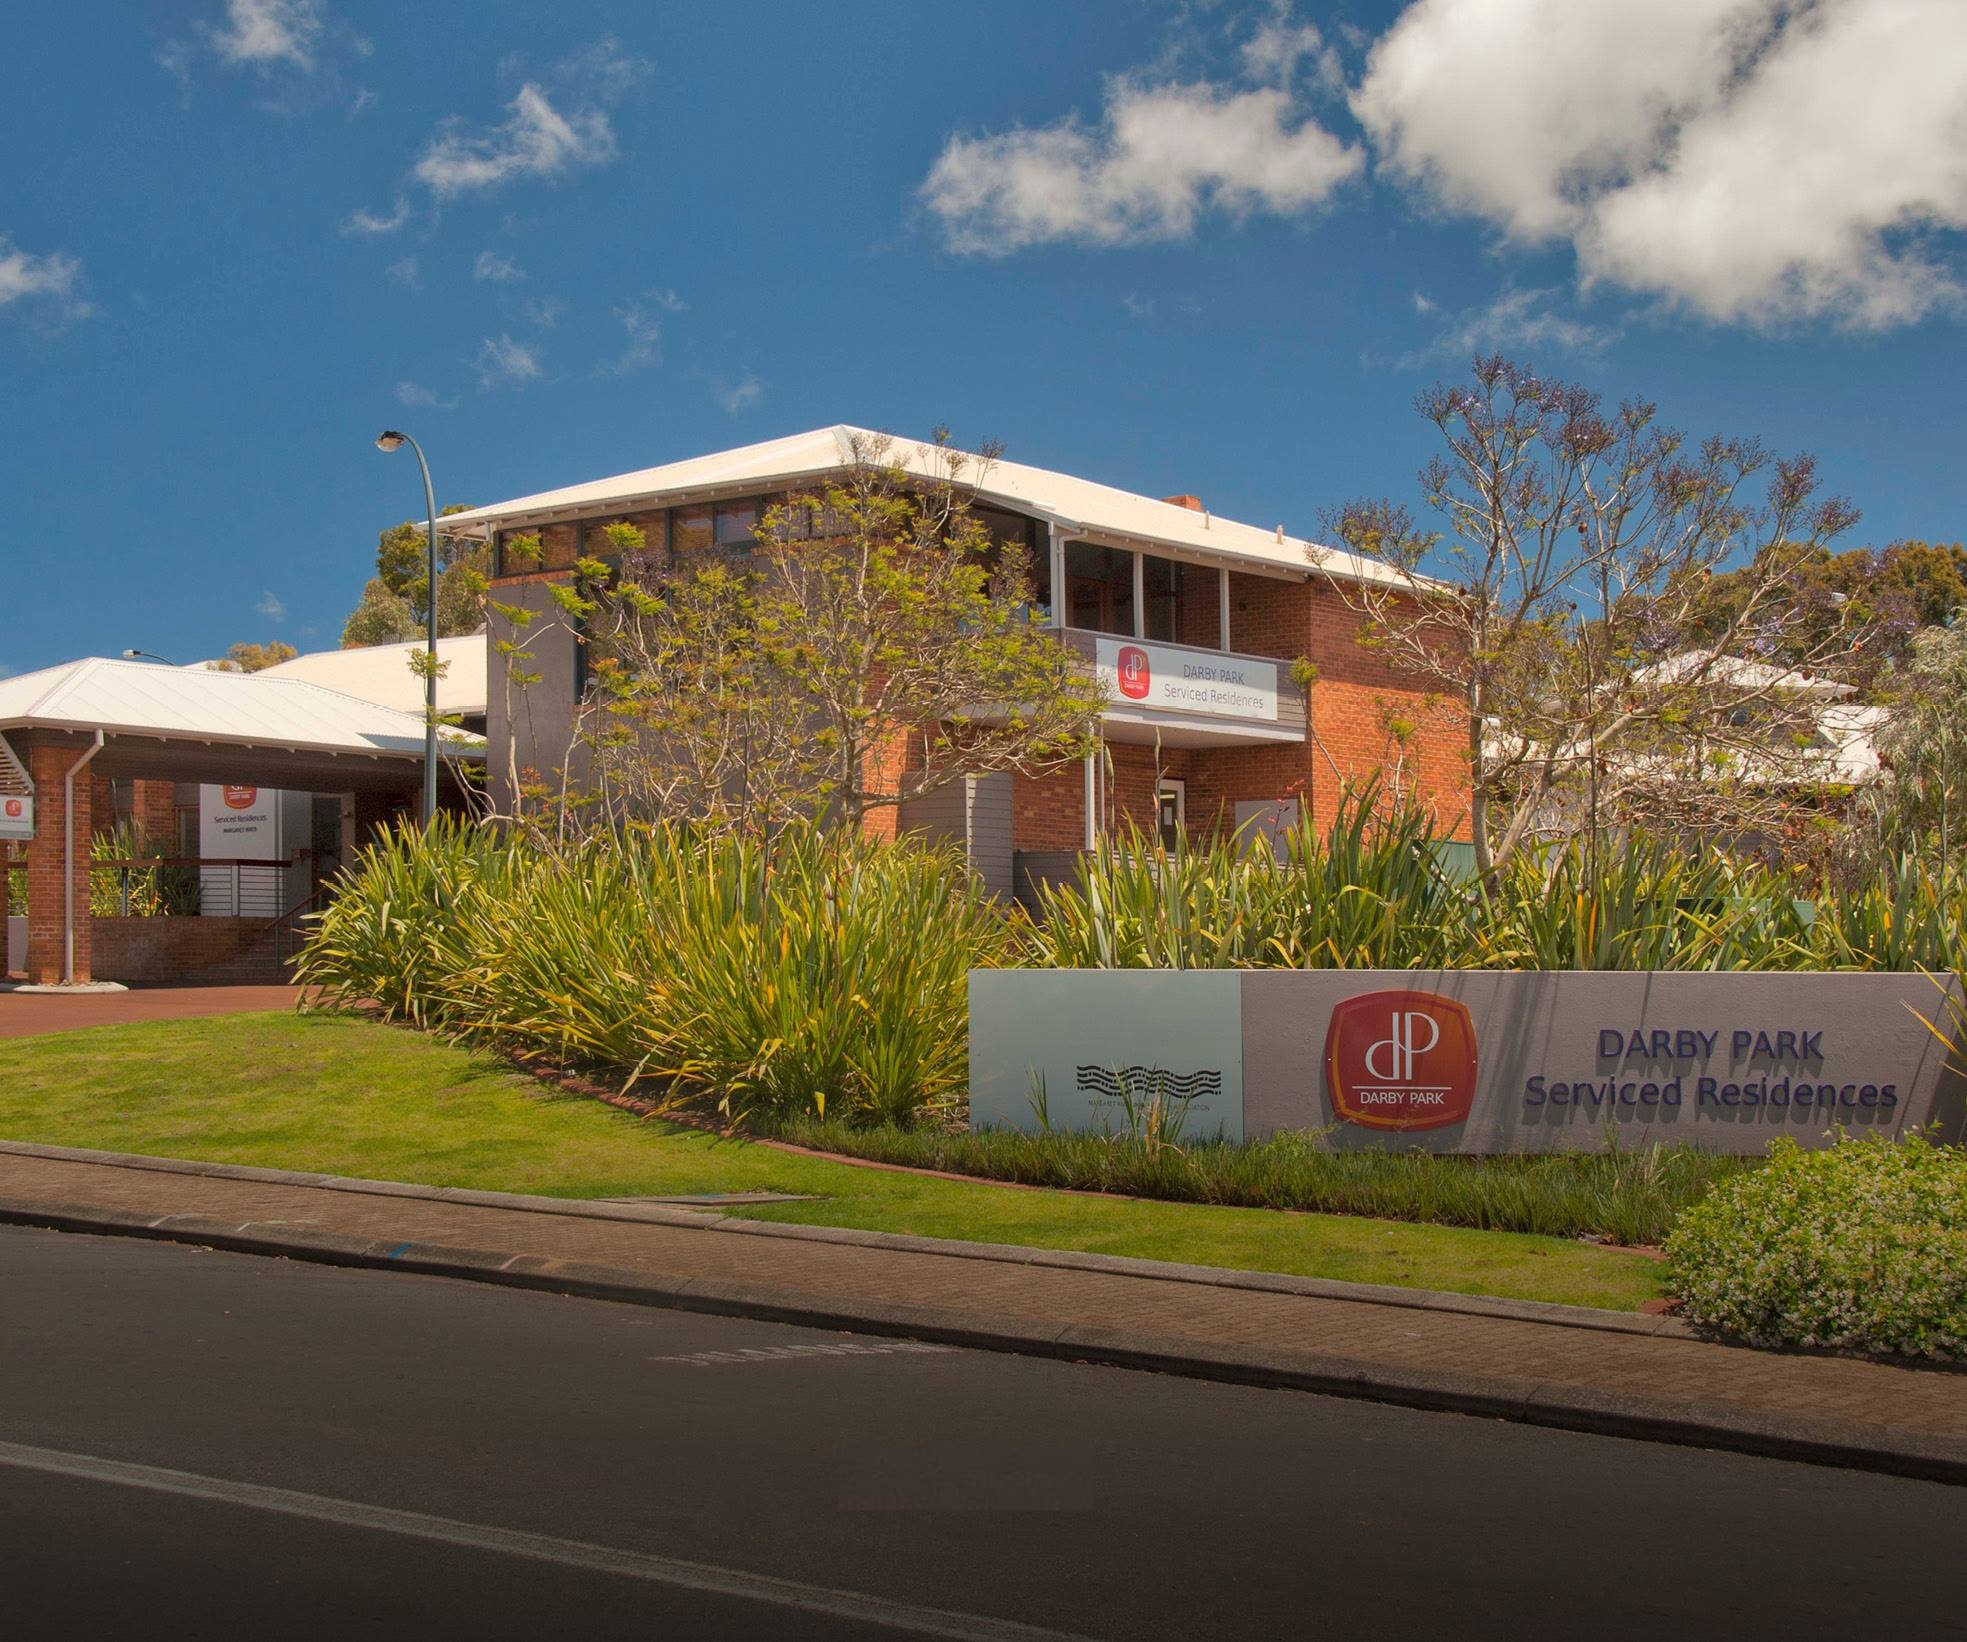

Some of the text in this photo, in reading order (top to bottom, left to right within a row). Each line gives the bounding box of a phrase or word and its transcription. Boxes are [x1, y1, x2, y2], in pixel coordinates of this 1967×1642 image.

[1183, 664, 1245, 686] DARBY PARK
[1164, 683, 1264, 709] Serviced Residences
[214, 813, 268, 824] Serviced Residences
[1599, 1029, 1824, 1061] DARBY PARK
[1360, 1092, 1445, 1105] DARBY PARK
[1525, 1074, 1898, 1108] Serviced Residences
